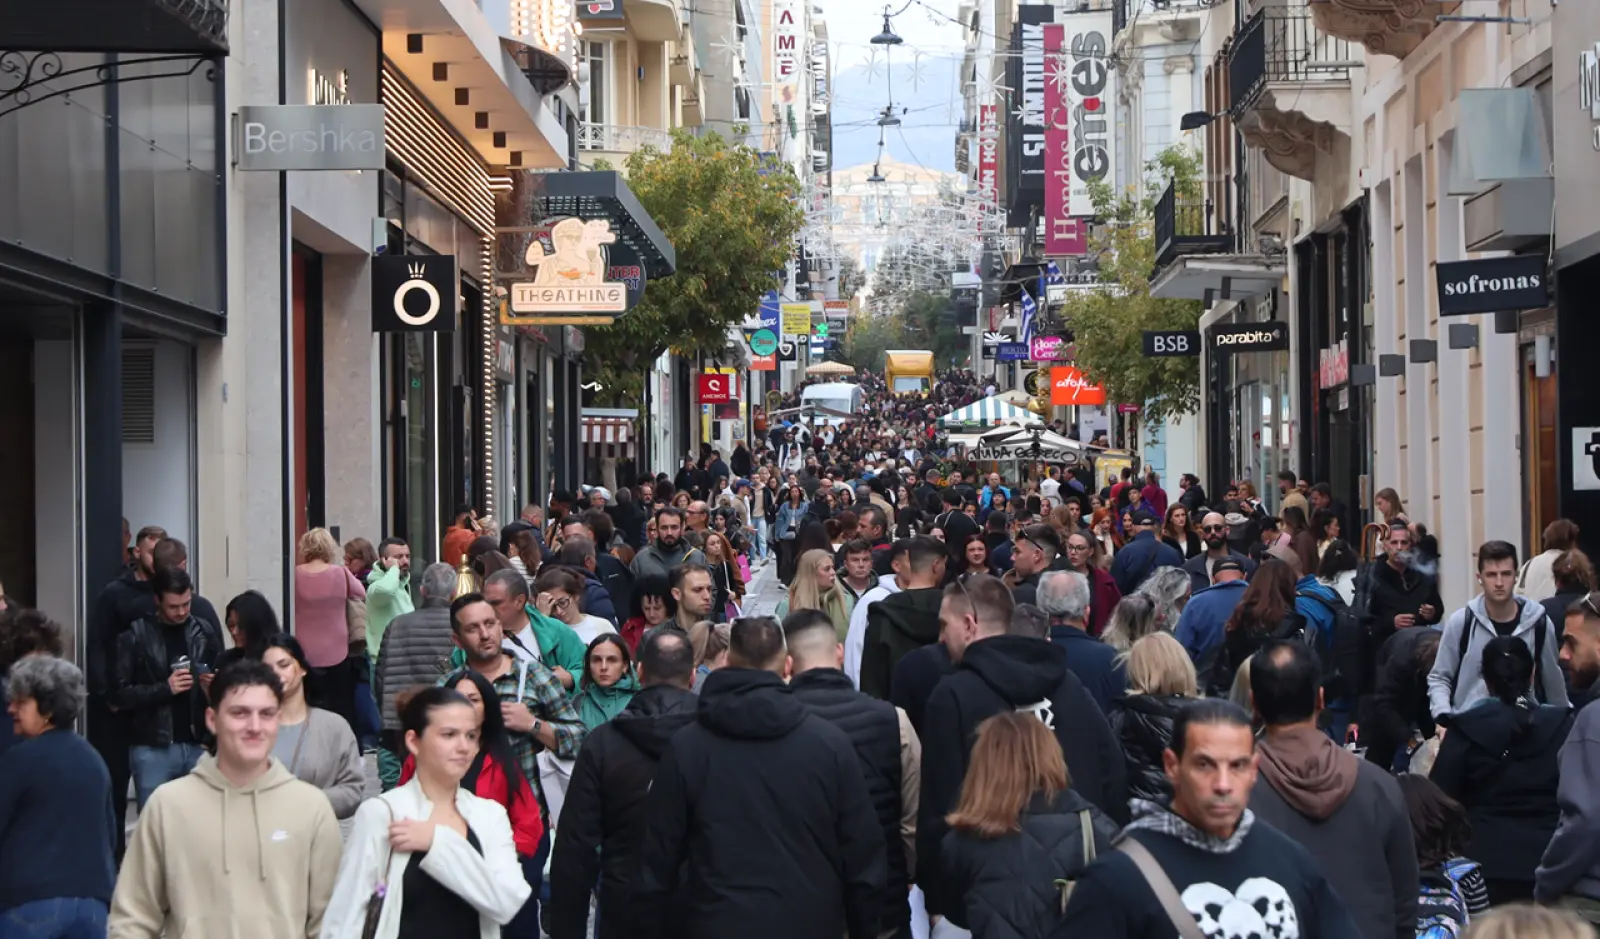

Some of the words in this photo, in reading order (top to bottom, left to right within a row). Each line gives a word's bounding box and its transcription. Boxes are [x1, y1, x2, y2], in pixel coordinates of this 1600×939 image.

[245, 122, 376, 153] Bershka
[983, 112, 996, 163] HOSE
[1444, 274, 1541, 295] sofronas
[1153, 335, 1189, 352] BSB
[1217, 330, 1272, 346] parabita
